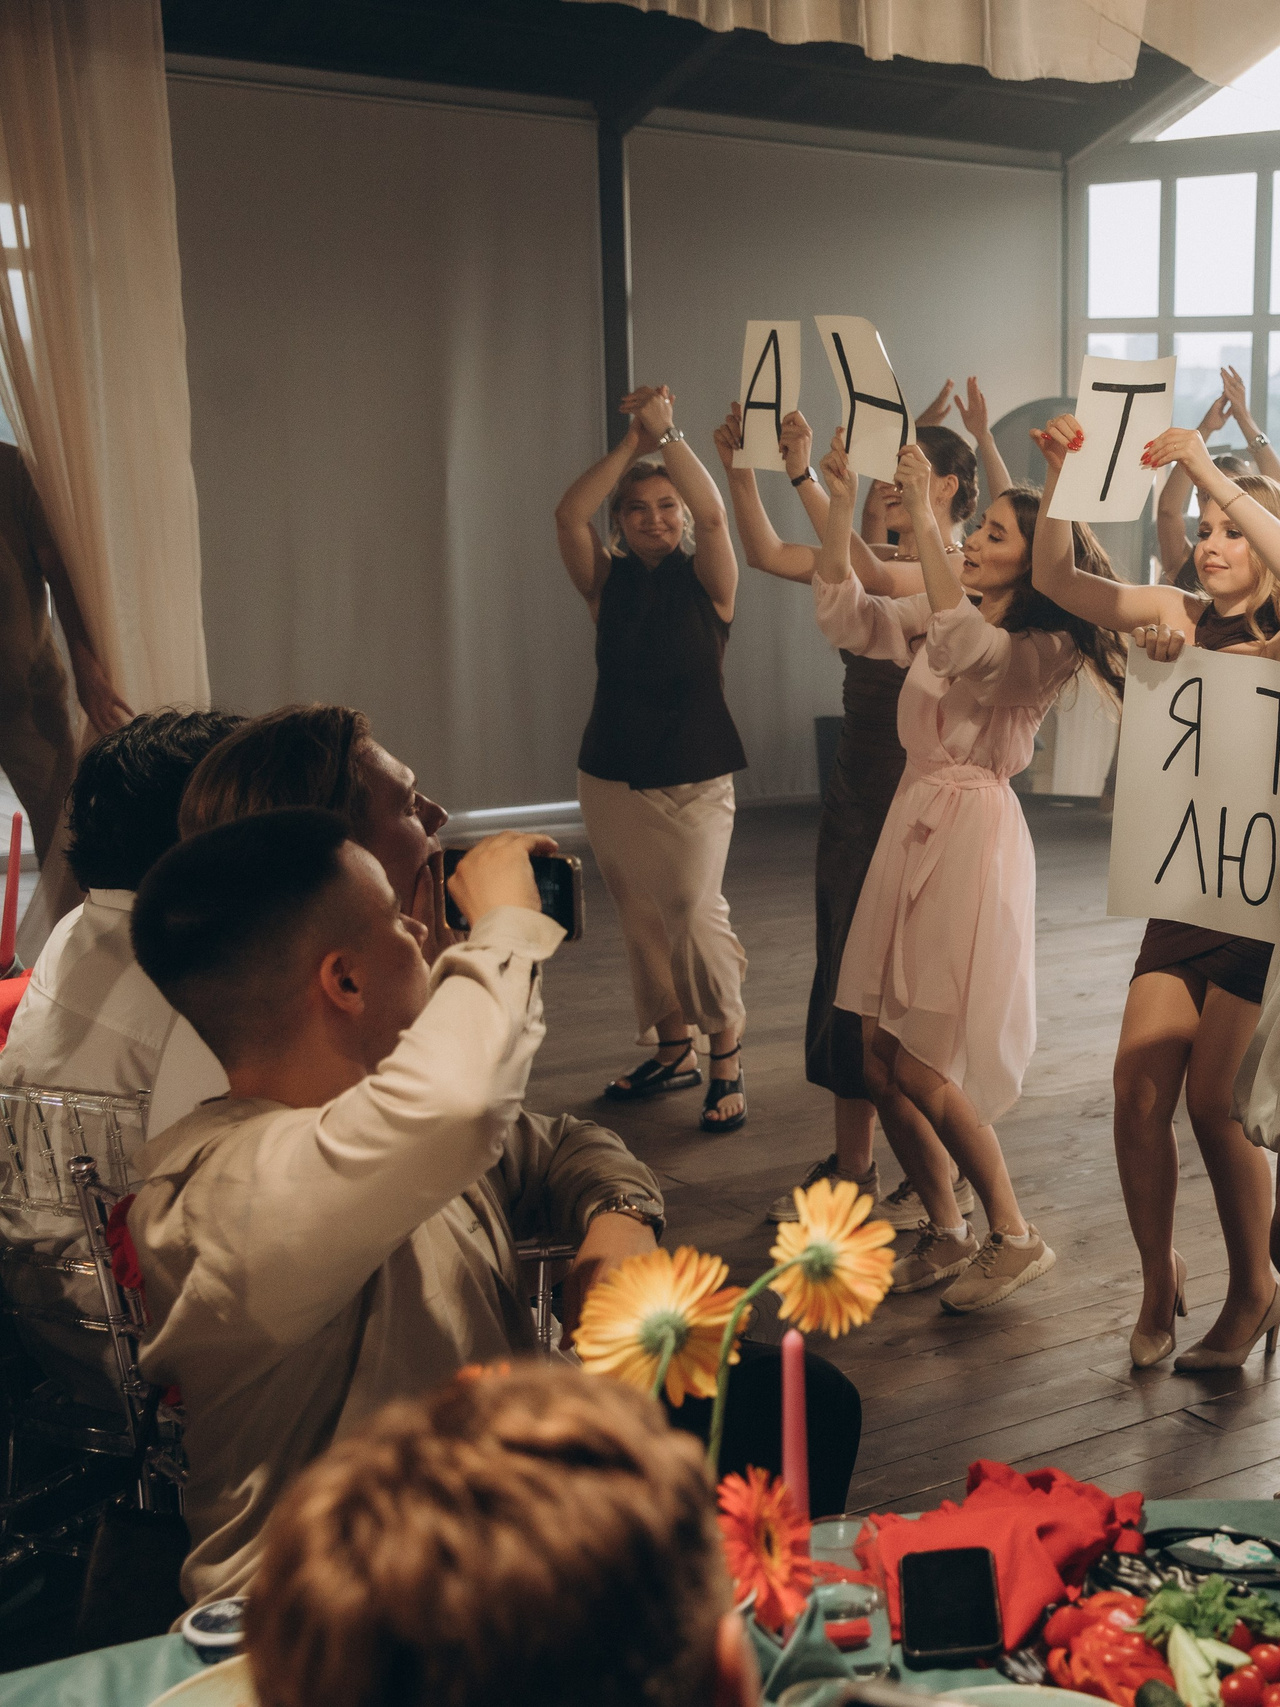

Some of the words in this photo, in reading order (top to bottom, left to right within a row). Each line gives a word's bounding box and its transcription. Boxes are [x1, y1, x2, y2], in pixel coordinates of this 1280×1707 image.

[740, 329, 781, 450] А
[1092, 382, 1166, 502] Т
[1162, 677, 1203, 776] Я
